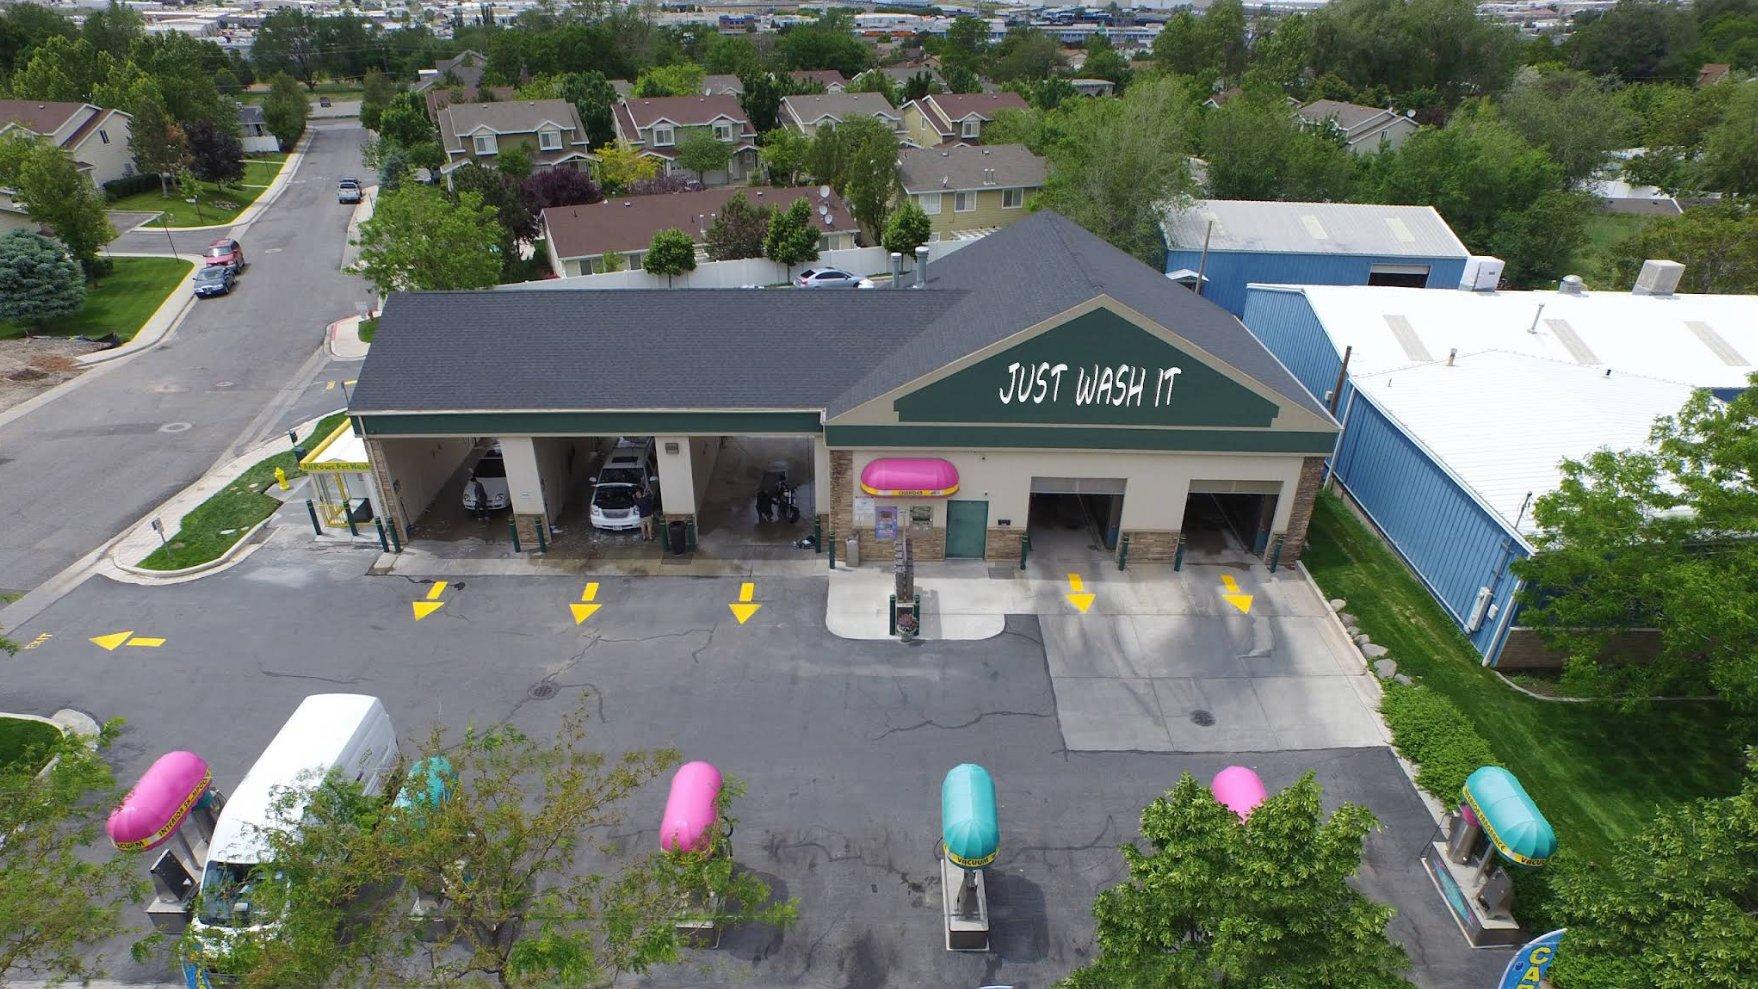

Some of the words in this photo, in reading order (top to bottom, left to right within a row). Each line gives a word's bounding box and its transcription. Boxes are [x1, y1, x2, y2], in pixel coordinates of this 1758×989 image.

[1000, 361, 1068, 404] JUST
[1075, 364, 1146, 407] WASH
[1155, 366, 1182, 408] IT
[336, 463, 349, 471] Pet
[957, 856, 989, 866] VACUUM
[1516, 946, 1552, 989] CA
